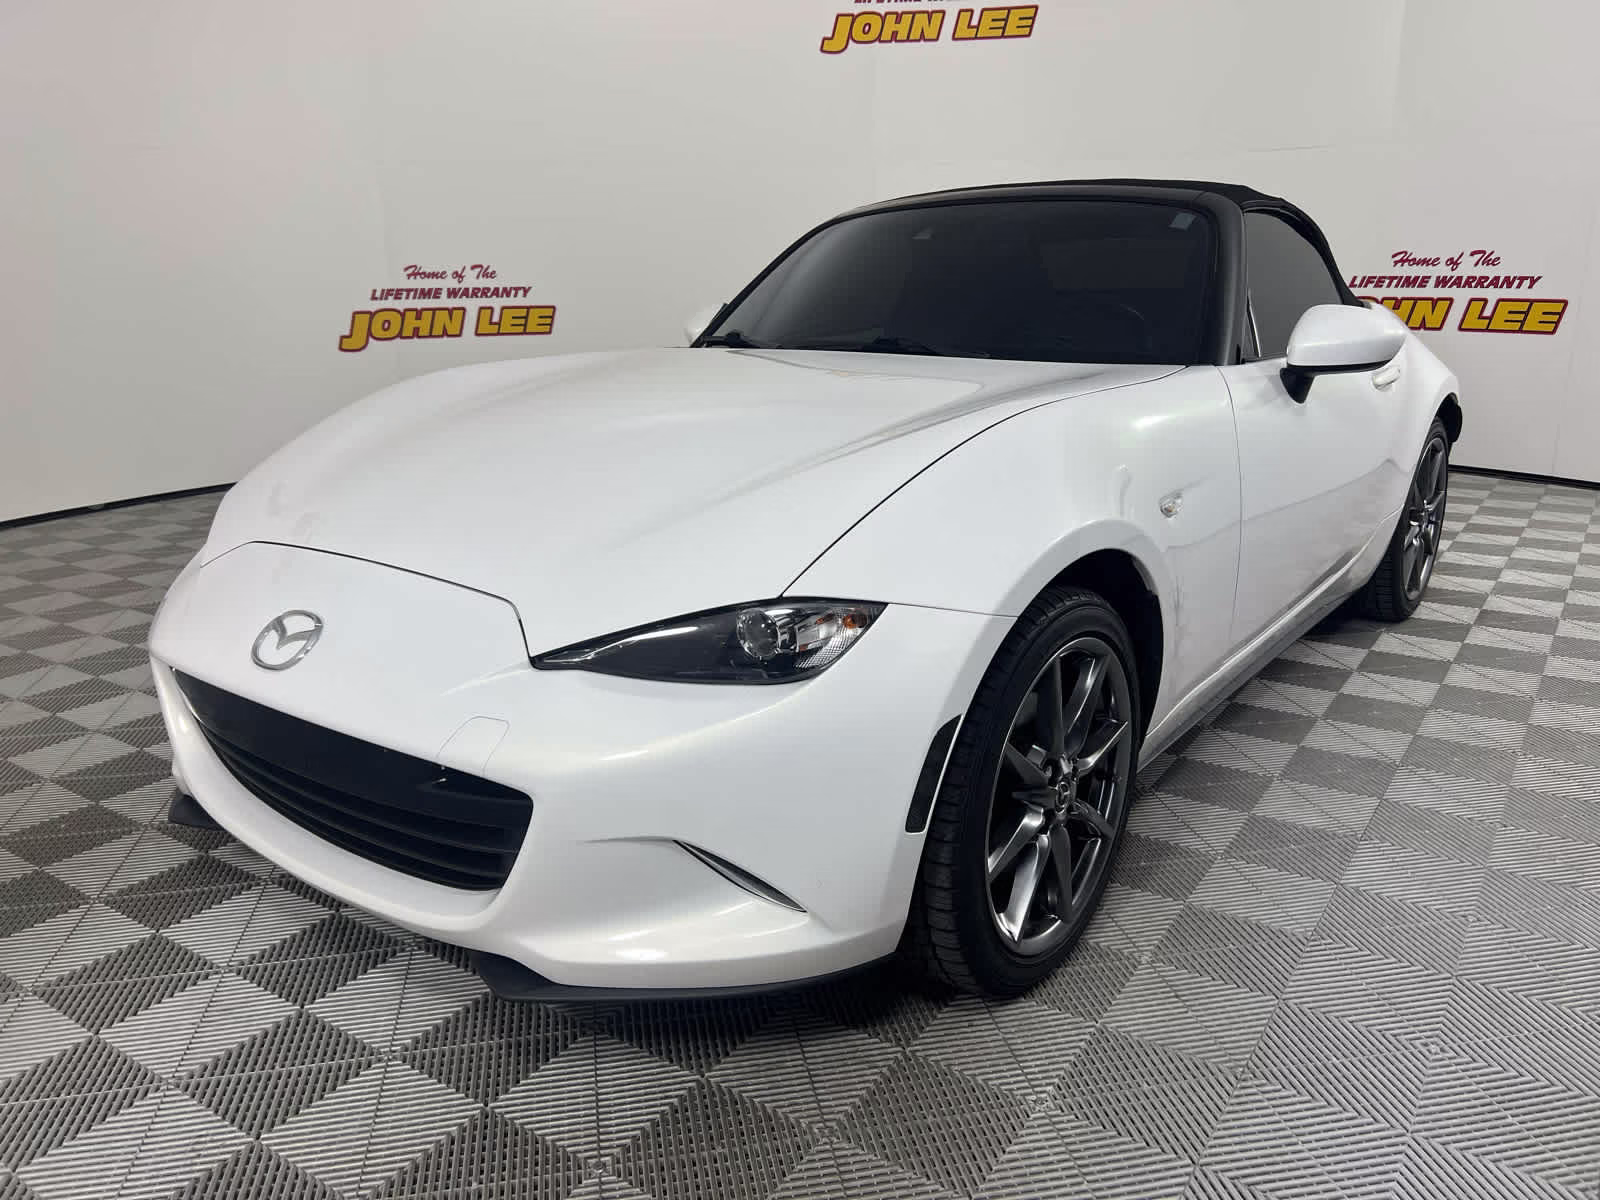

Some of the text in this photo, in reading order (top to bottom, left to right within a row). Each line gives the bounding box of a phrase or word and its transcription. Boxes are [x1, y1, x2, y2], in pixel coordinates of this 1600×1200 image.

[820, 5, 1039, 54] JOHN LEE
[1391, 249, 1501, 271] Home of The
[403, 264, 497, 284] Home of The
[1349, 275, 1543, 290] LIFETIME WARRANTY
[370, 286, 532, 301] LIFETIME WARRANTY
[1457, 297, 1569, 335] LEE
[338, 305, 556, 352] JOHN LEE
